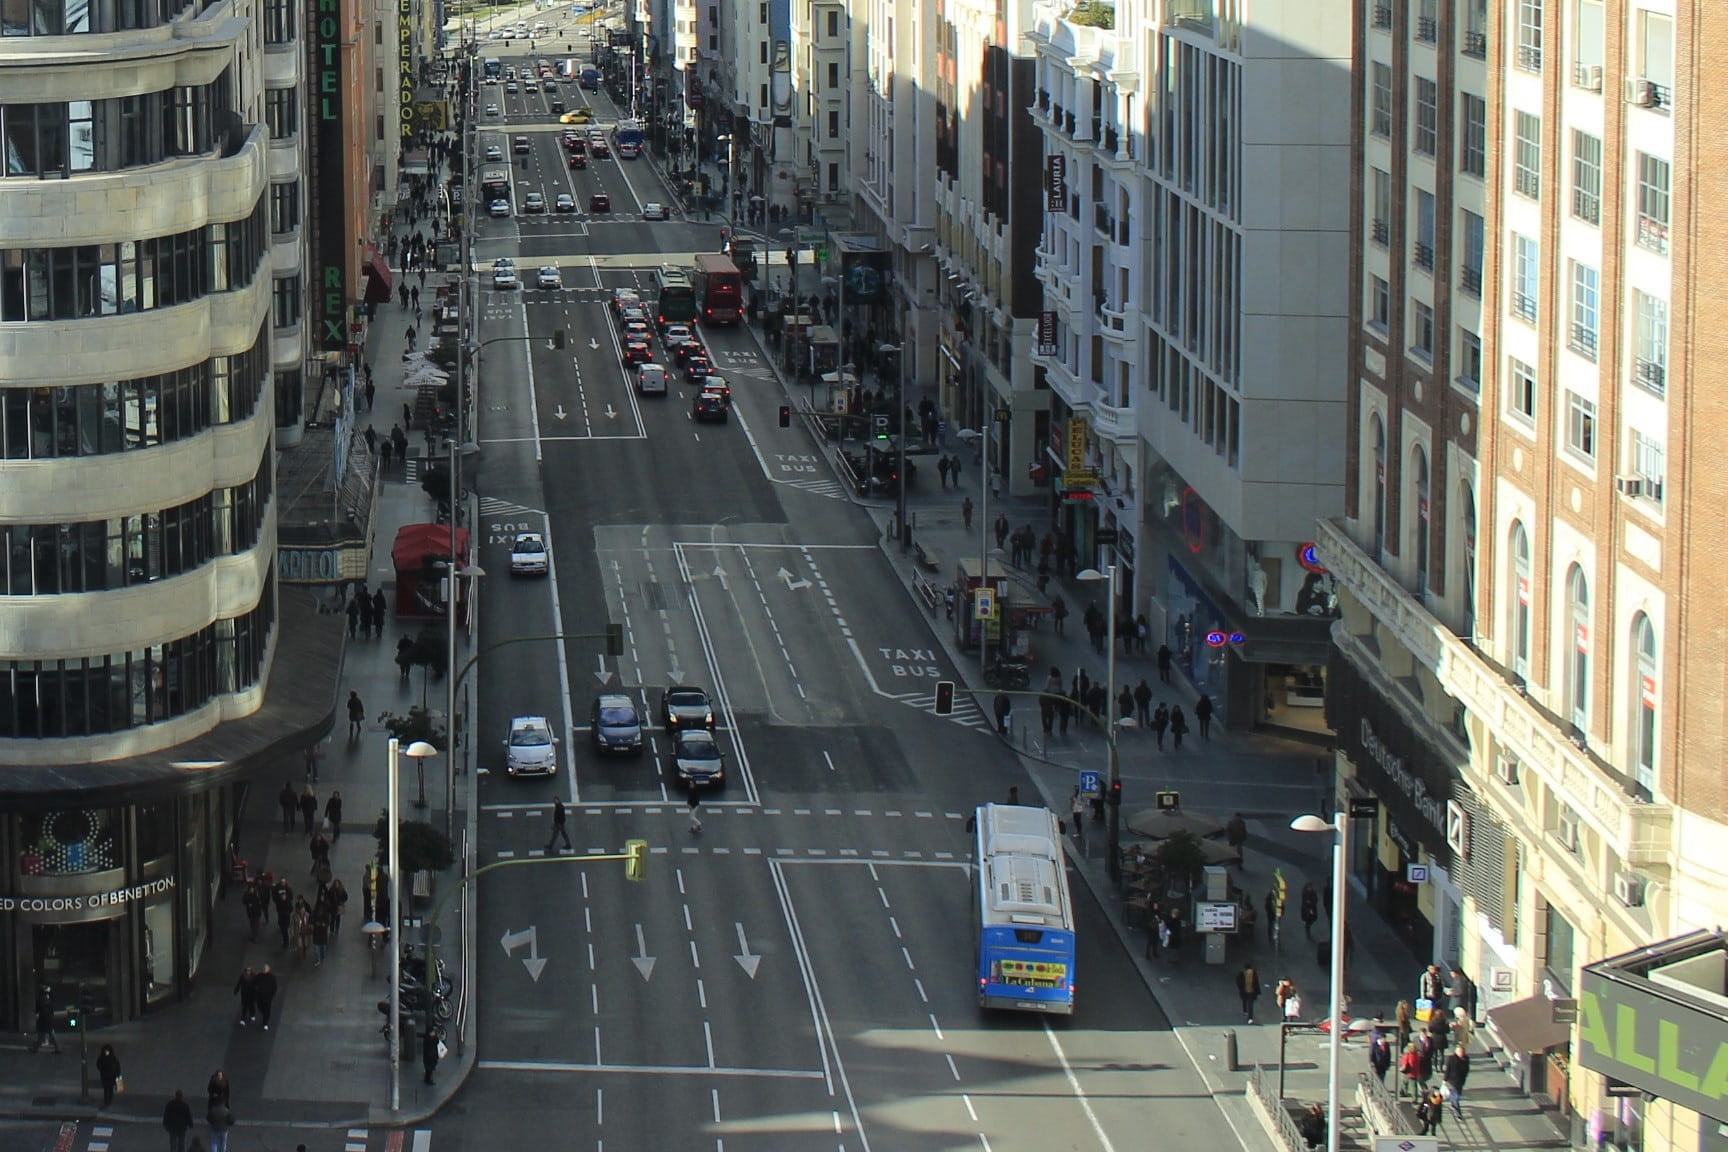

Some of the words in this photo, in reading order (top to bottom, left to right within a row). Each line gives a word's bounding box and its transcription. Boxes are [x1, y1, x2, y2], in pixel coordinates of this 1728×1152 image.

[399, 0, 413, 136] EMPERADOR
[1053, 158, 1062, 198] LAURIA
[324, 266, 343, 341] REX
[775, 454, 818, 462] TAXI
[781, 464, 816, 473] BUS
[491, 523, 529, 532] BUS
[489, 536, 515, 545] XI
[277, 550, 342, 580] APITOL
[879, 648, 936, 661] TAXI
[892, 665, 941, 678] BUS
[1086, 775, 1096, 789] P
[1361, 717, 1414, 798] Deutsche
[1414, 777, 1445, 836] Bank
[20, 898, 82, 912] COLORS
[88, 893, 110, 908] OF
[1005, 976, 1017, 985] La
[1018, 977, 1054, 988] Cubana
